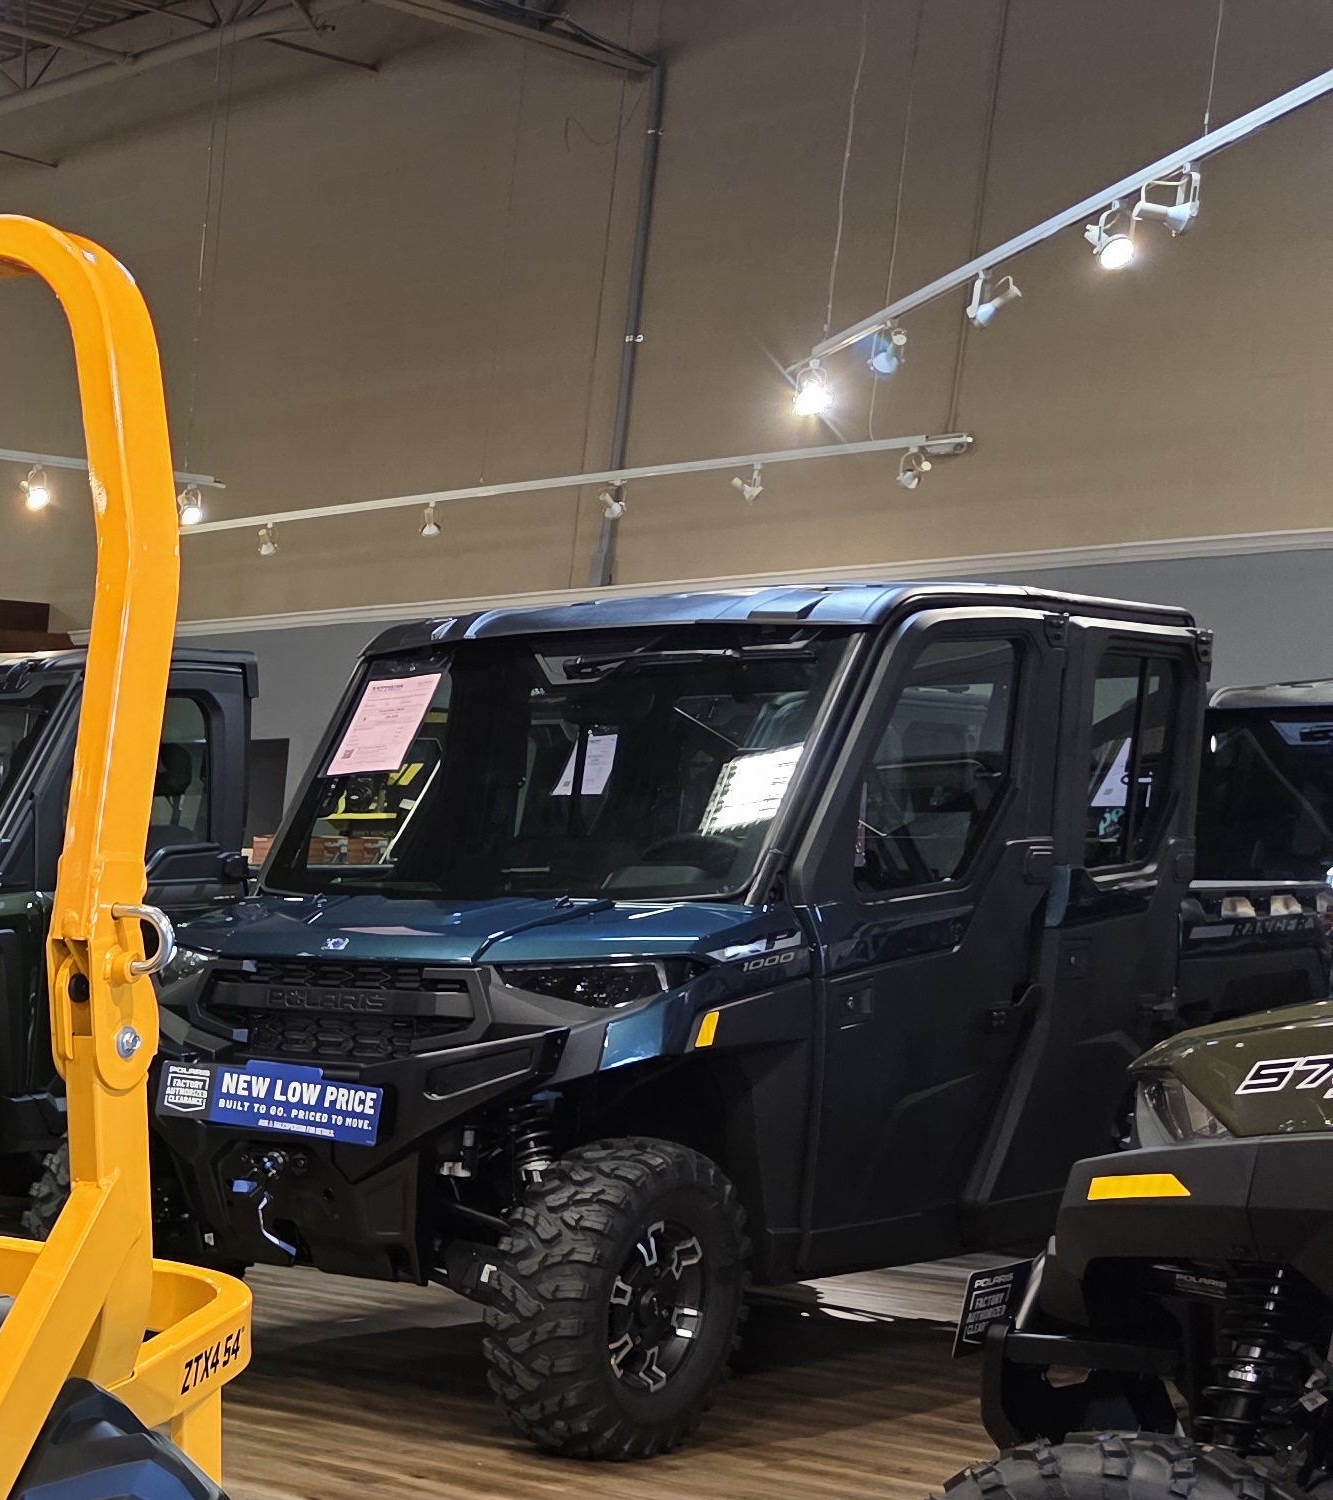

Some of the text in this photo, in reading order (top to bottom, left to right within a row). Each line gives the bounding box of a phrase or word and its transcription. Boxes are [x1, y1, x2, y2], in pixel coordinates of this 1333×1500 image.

[743, 952, 795, 972] 1000
[267, 988, 386, 1012] POLARIS
[169, 1065, 211, 1076] POLARIS
[1235, 1054, 1333, 1095] 57
[166, 1086, 208, 1098] AUTHORIZED
[173, 1078, 203, 1089] FACTORY
[168, 1095, 203, 1105] CLEARANCE
[221, 1072, 377, 1114] NEW LOW PRICE
[218, 1098, 372, 1130] BUILT TO GO. PRICED TO MOVE.
[974, 1272, 1014, 1289] POLARIS
[1175, 1273, 1228, 1289] POLARIS
[974, 1292, 1005, 1309] FACTORY
[966, 1304, 1007, 1323] AUTHORIZED
[180, 1341, 221, 1395] ZTX4
